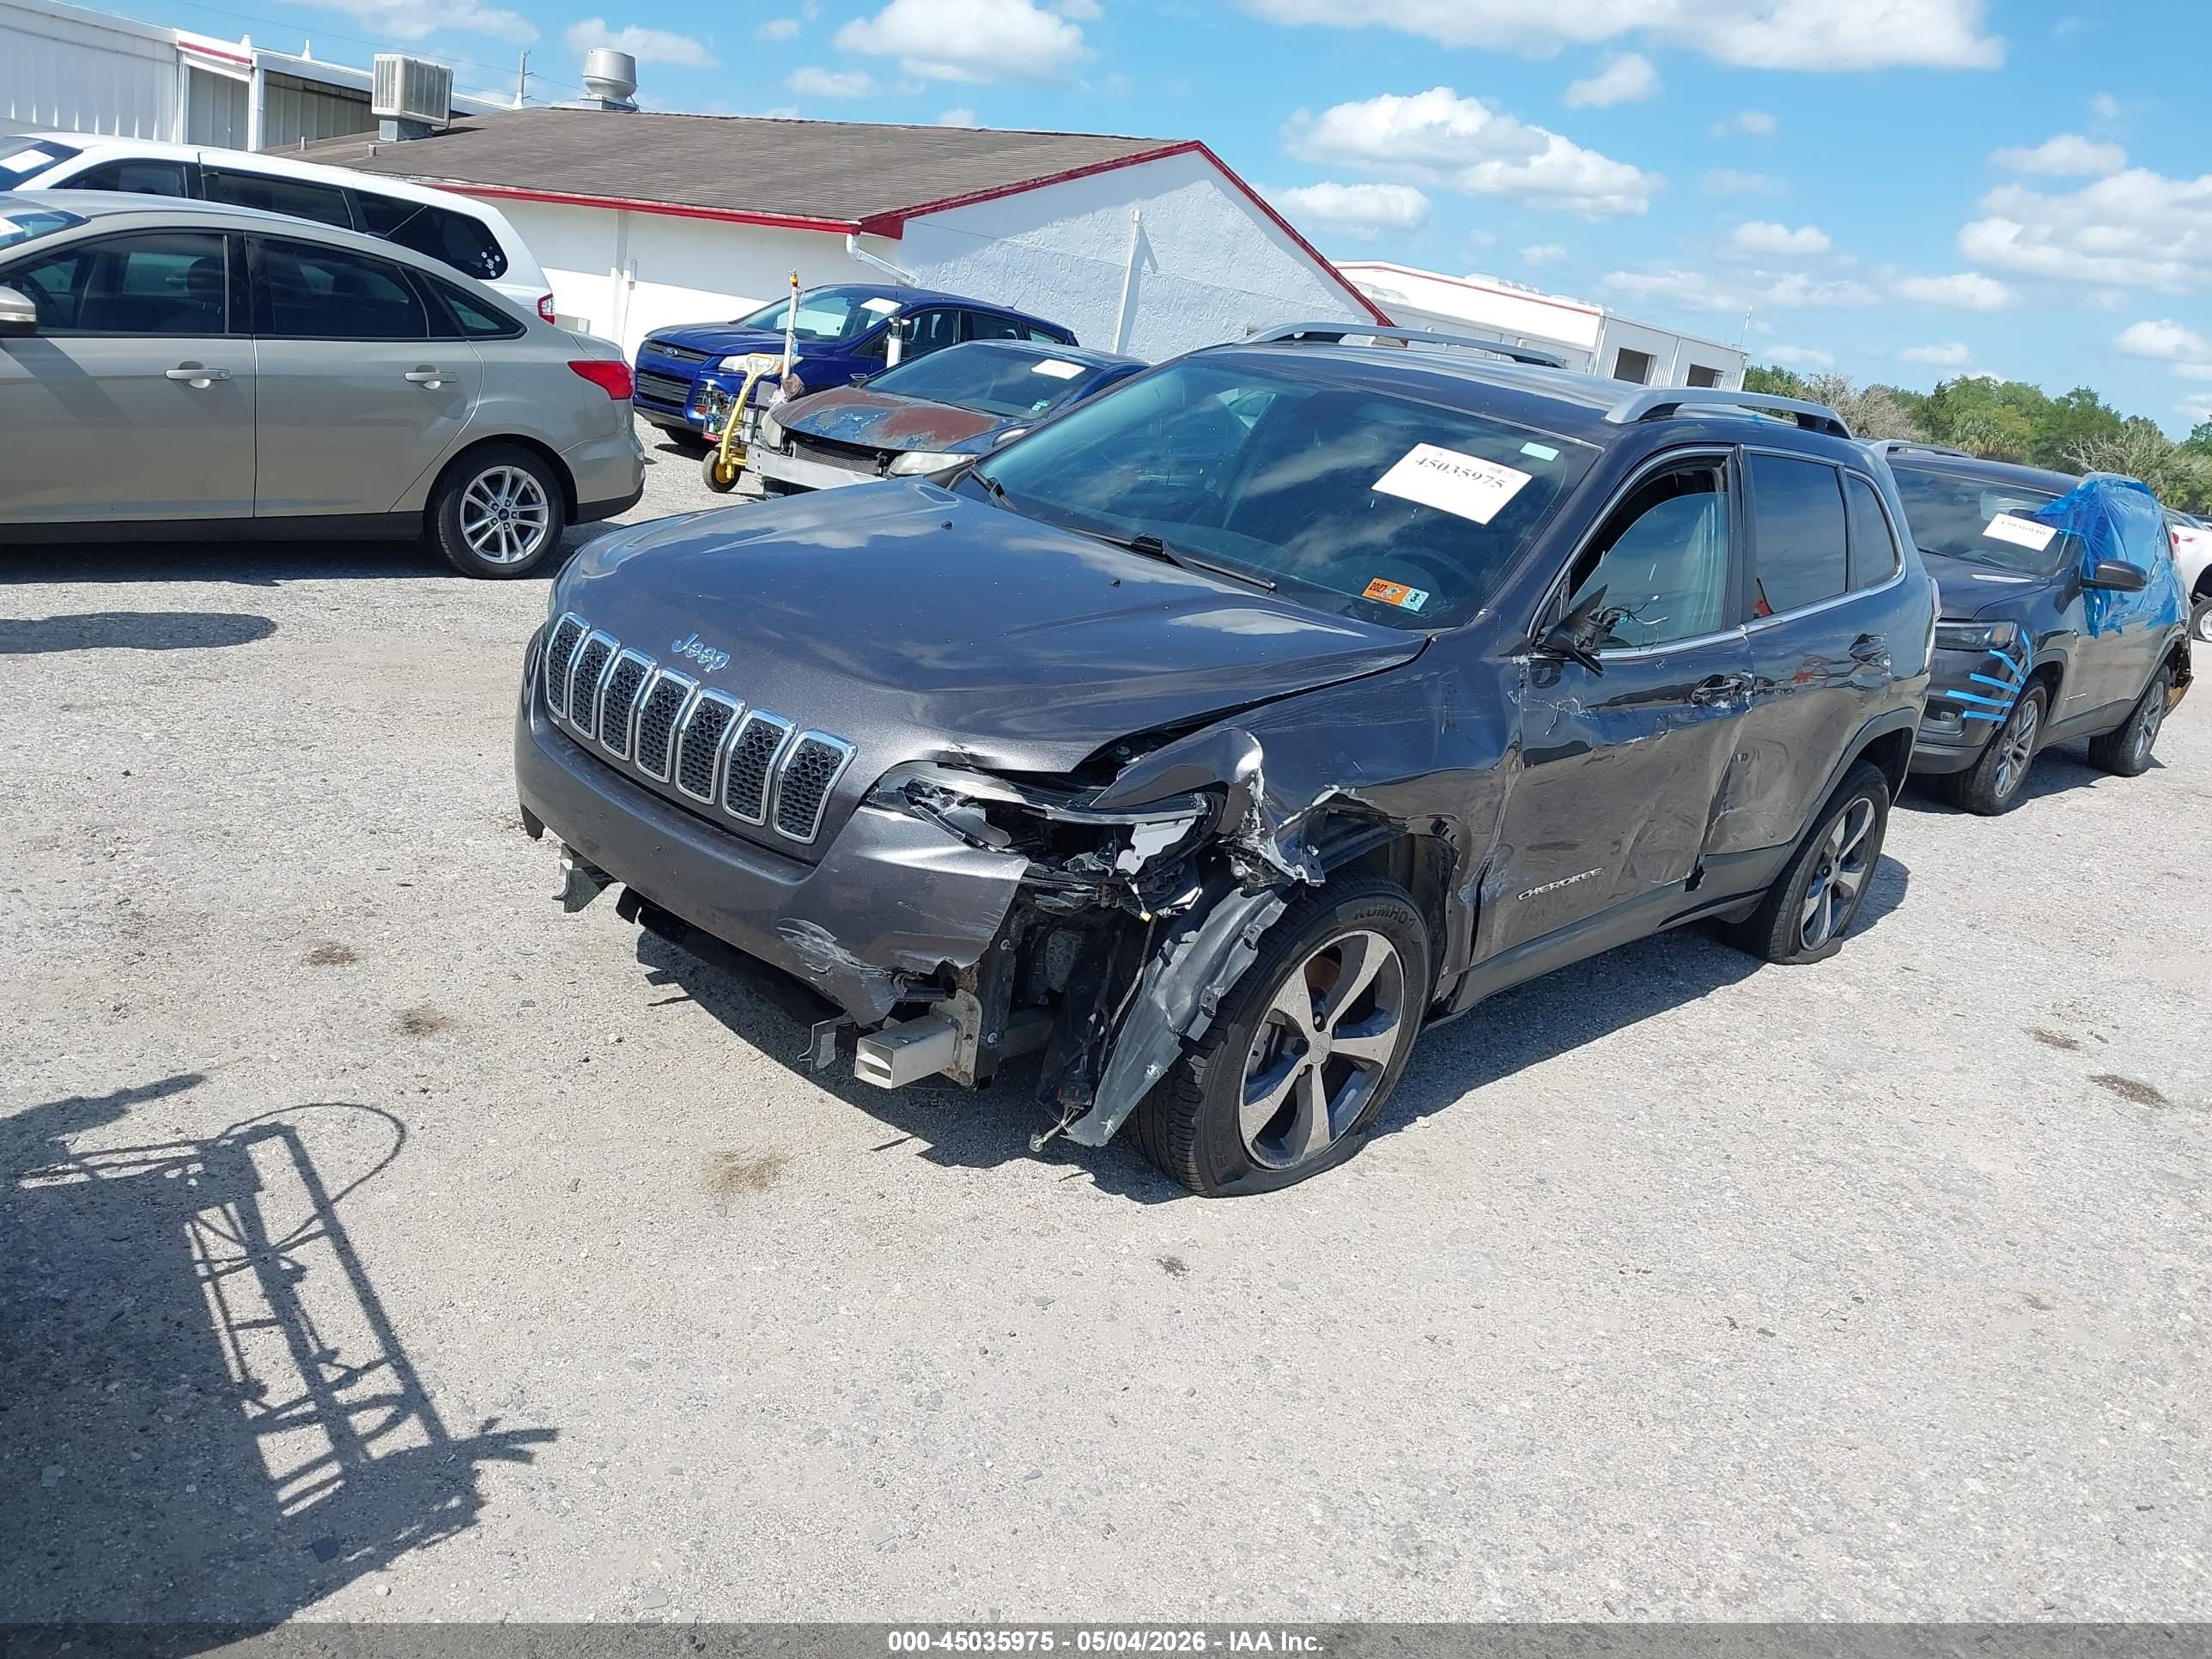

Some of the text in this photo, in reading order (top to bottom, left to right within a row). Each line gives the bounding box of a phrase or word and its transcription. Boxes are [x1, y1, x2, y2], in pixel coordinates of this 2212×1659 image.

[1415, 457, 1507, 489] 45035975
[1369, 581, 1388, 593] 2027
[1410, 592, 1420, 603] 3
[672, 632, 731, 673] Jeep
[1516, 866, 1603, 901] CHEROKEE
